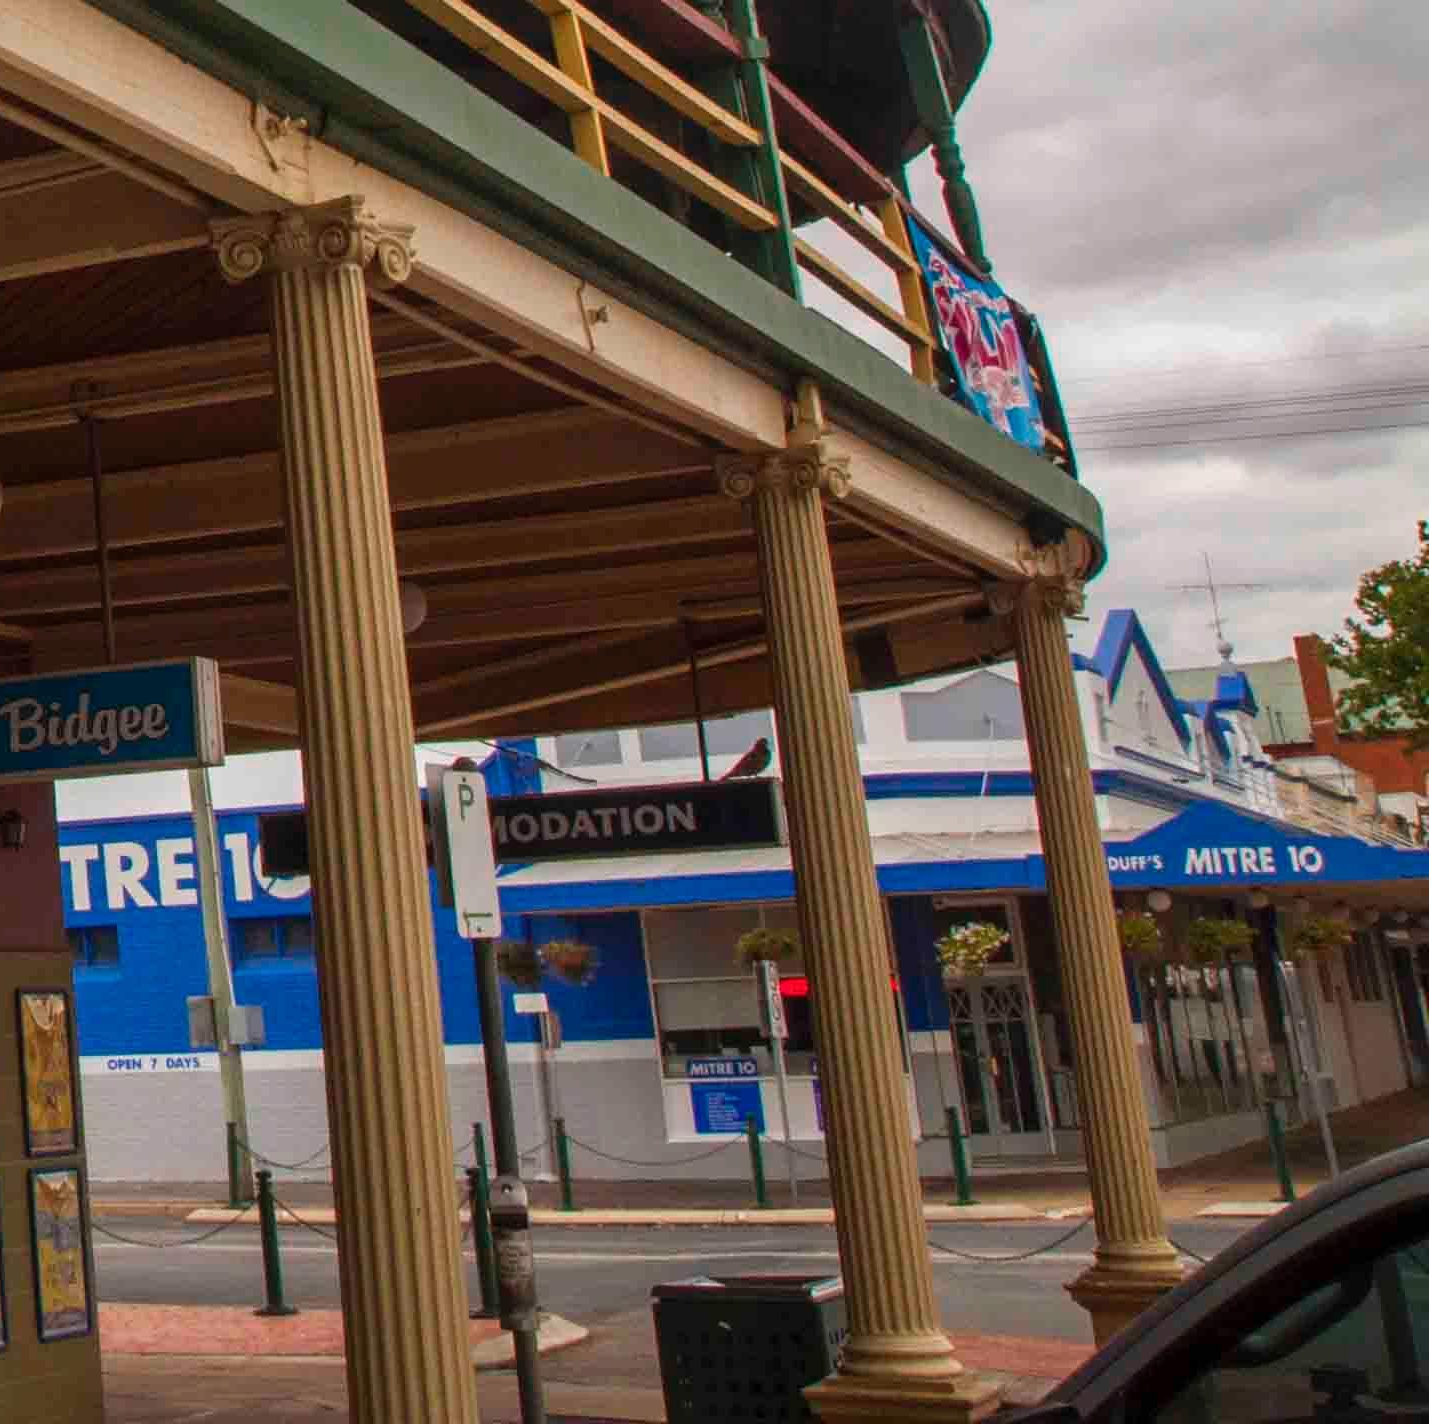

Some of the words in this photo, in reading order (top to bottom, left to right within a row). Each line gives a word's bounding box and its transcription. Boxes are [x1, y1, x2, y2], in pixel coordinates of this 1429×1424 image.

[457, 784, 475, 821] P
[1107, 854, 1164, 871] DUFF'S
[1184, 847, 1277, 876] MITRE
[1288, 845, 1323, 874] 10
[107, 1058, 141, 1070] OPEN
[151, 1058, 158, 1070] 7
[166, 1057, 201, 1069] DAYS
[691, 1062, 734, 1076] MITRE
[737, 1060, 756, 1075] 10
